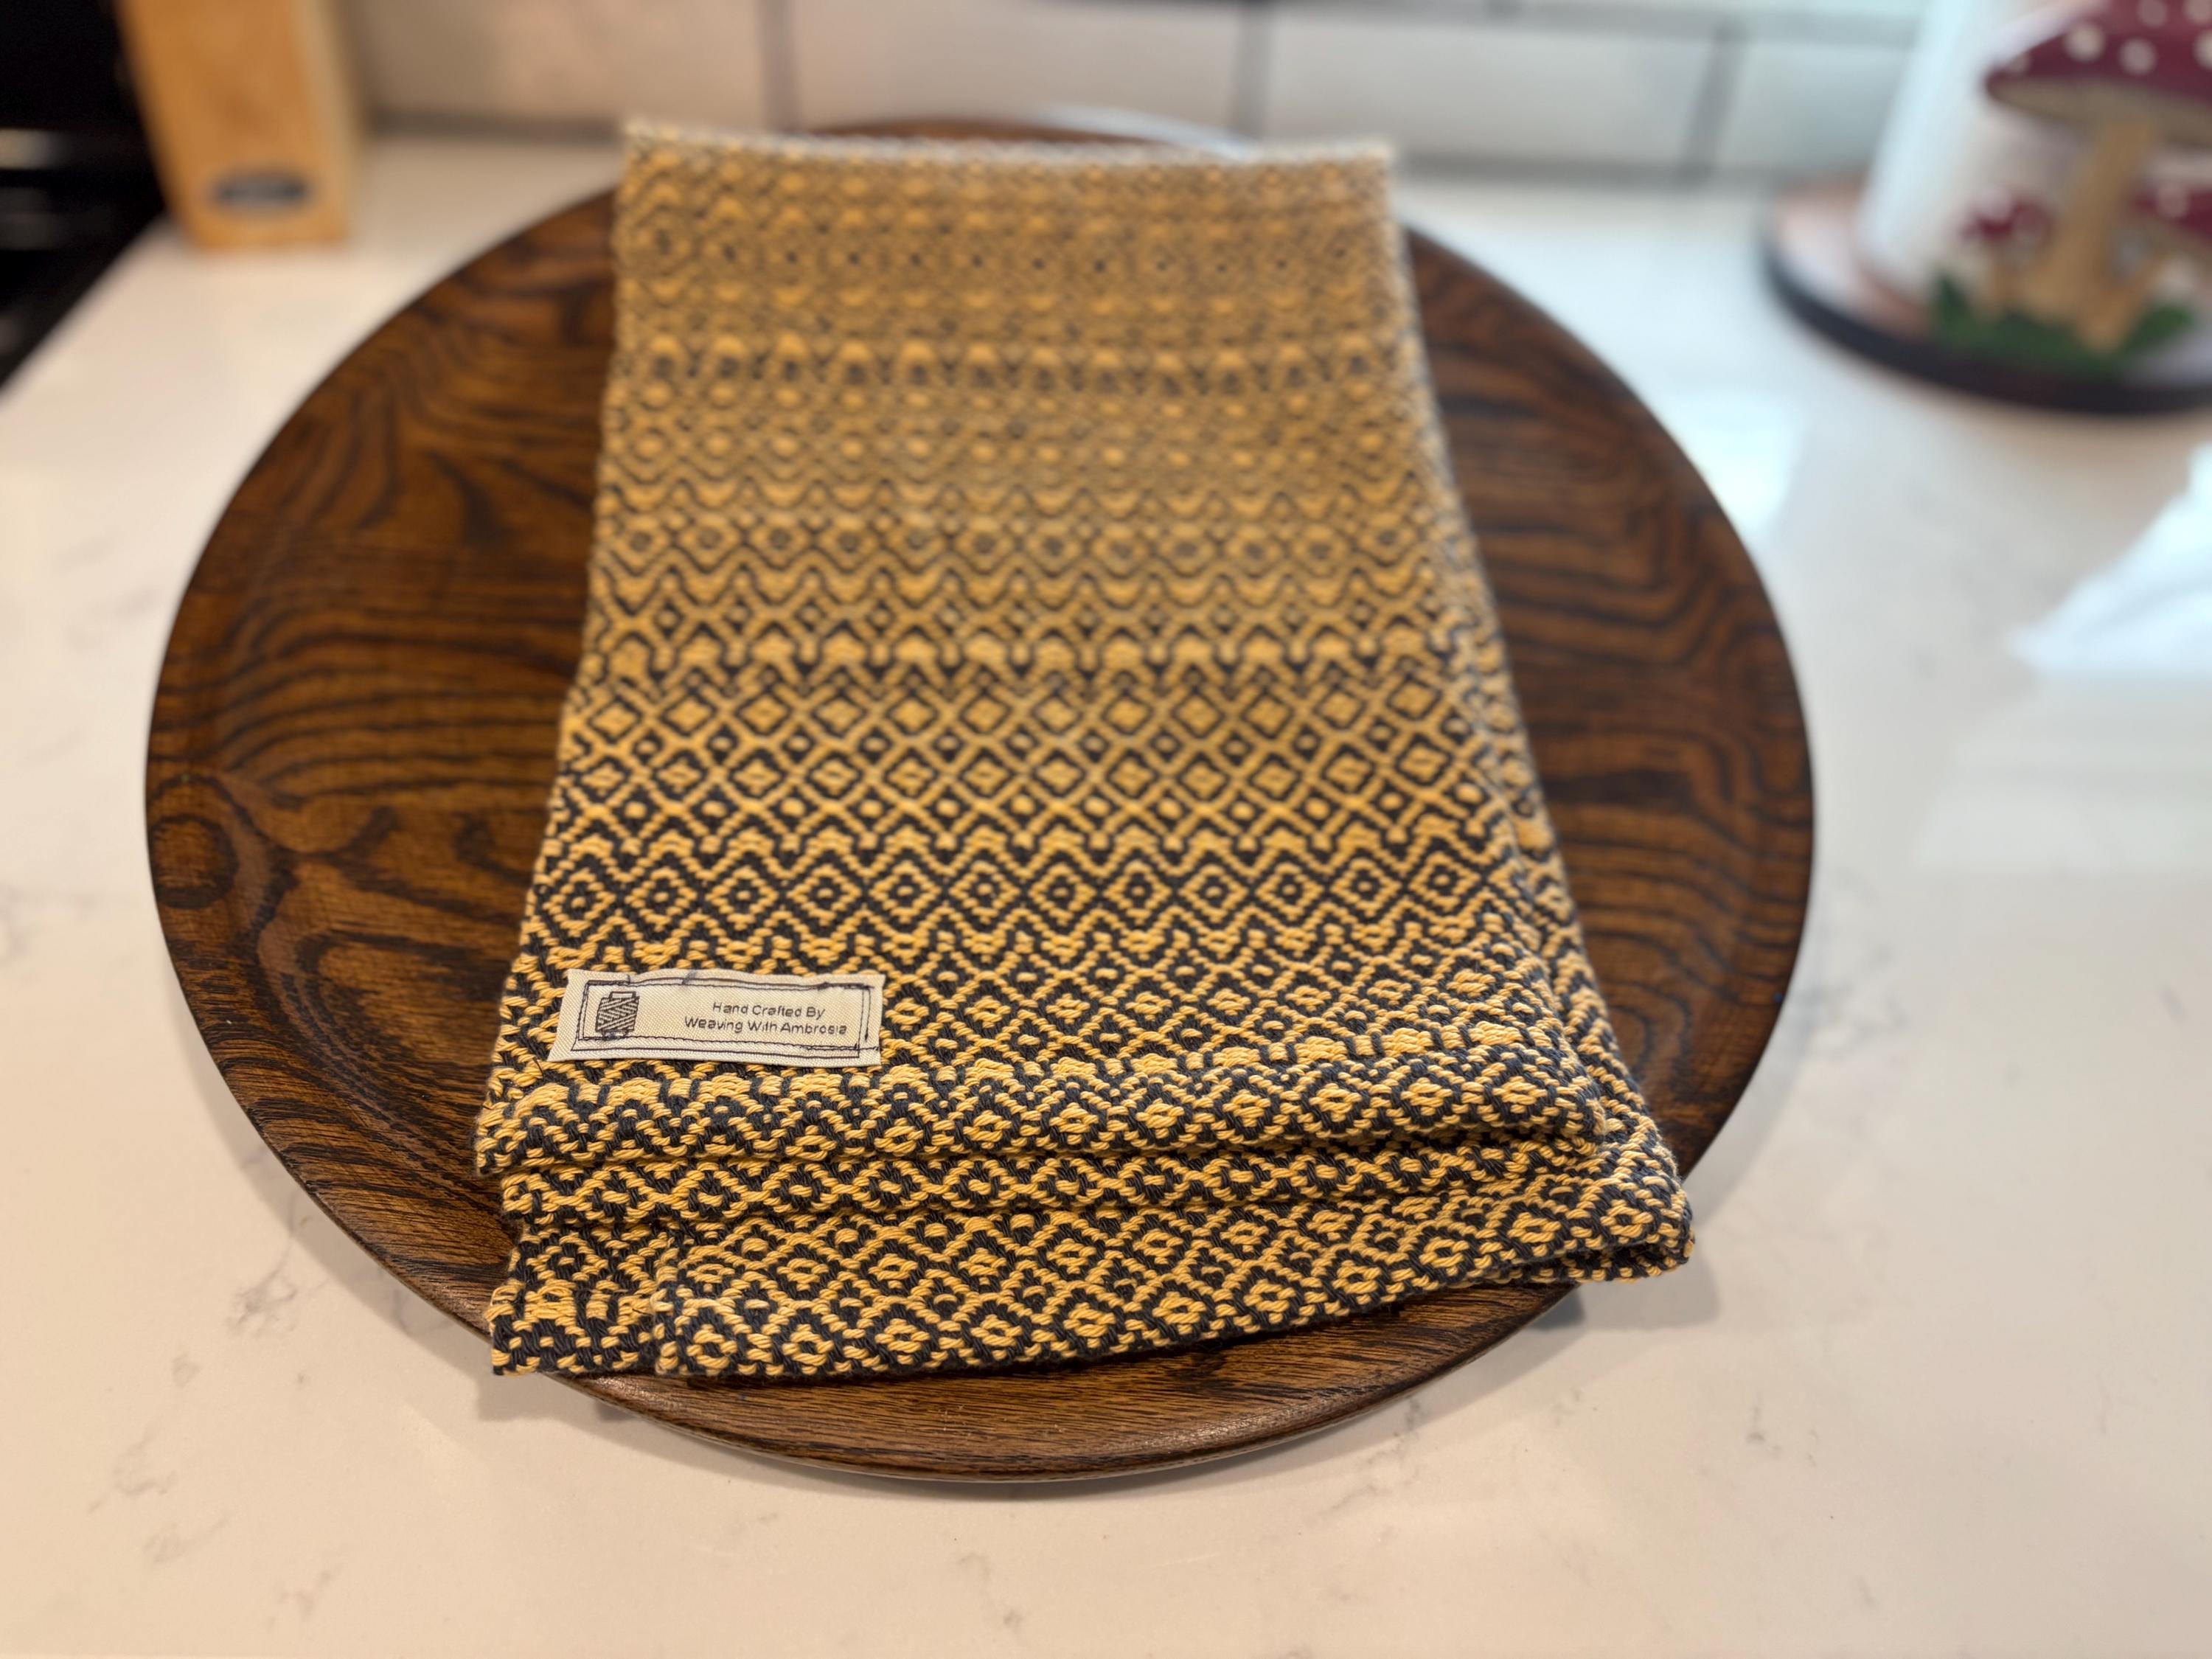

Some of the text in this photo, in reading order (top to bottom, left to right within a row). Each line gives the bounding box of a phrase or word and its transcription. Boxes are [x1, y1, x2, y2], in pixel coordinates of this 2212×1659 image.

[712, 1001, 825, 1020] Hand Crafted By
[684, 1016, 847, 1034] Weaving With Ambrosia
